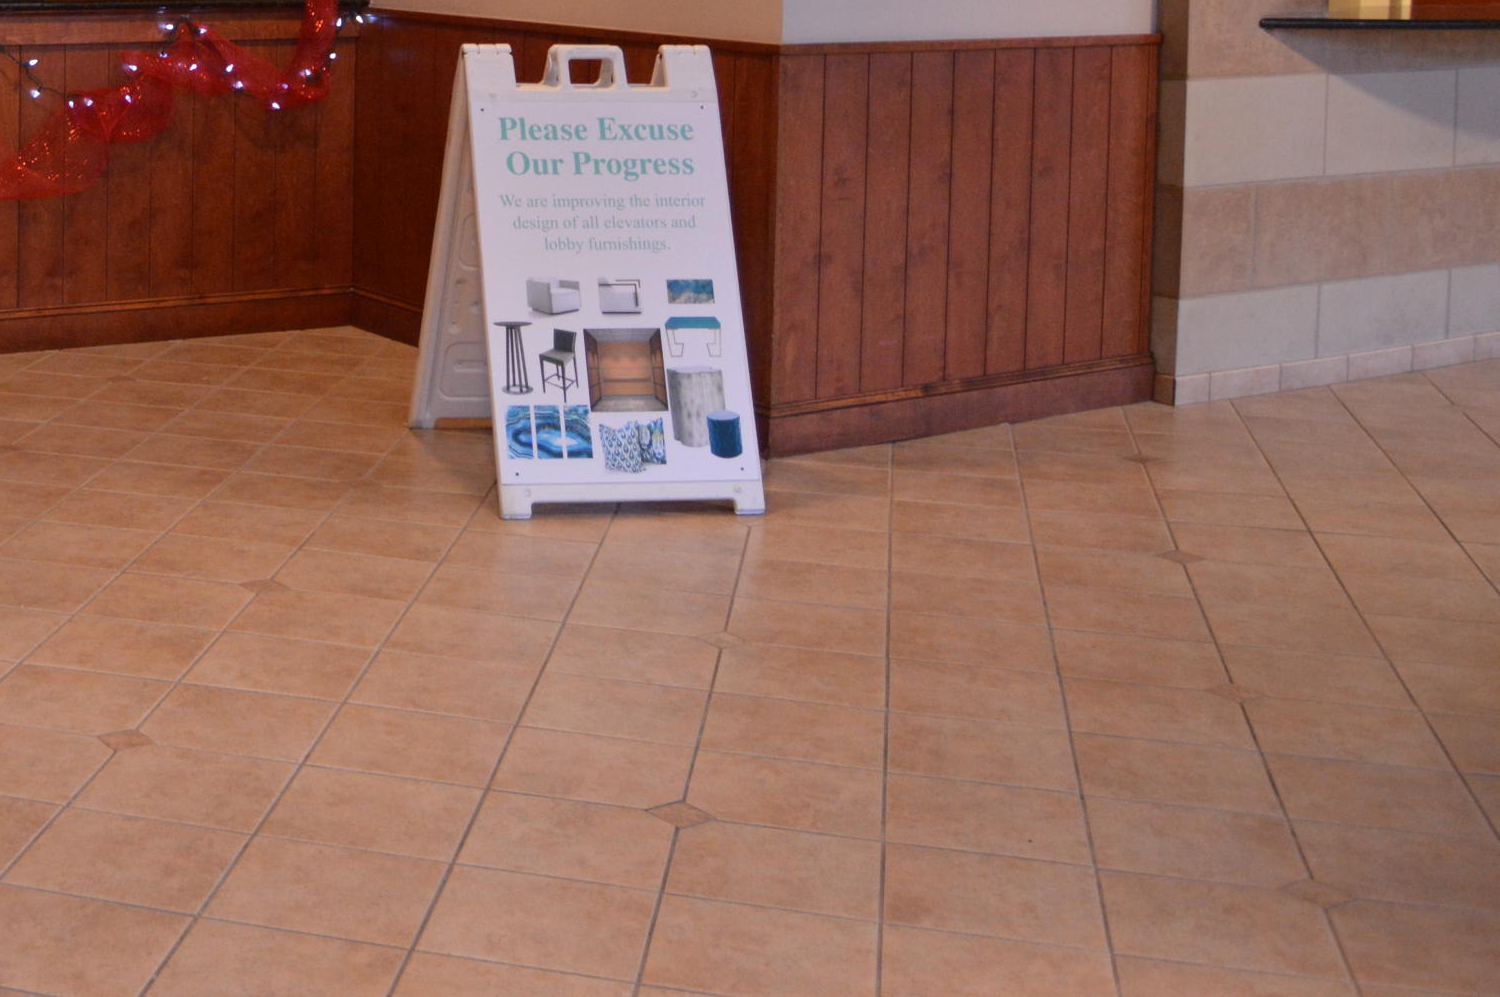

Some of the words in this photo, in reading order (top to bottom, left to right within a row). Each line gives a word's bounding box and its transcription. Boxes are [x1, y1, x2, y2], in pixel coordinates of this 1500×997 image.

[498, 116, 588, 142] Please
[597, 116, 694, 141] Excuse
[506, 150, 564, 177] Our
[573, 150, 695, 182] Progress
[499, 194, 522, 208] We
[526, 197, 548, 208] are
[552, 193, 625, 211] improving
[629, 194, 650, 207] the
[655, 193, 705, 207] interior
[512, 216, 559, 233] design
[563, 215, 581, 229] of
[582, 215, 600, 229] all
[603, 215, 668, 229] elevators
[671, 214, 697, 229] and
[544, 236, 583, 254] lobby
[588, 236, 671, 254] furnishings.
